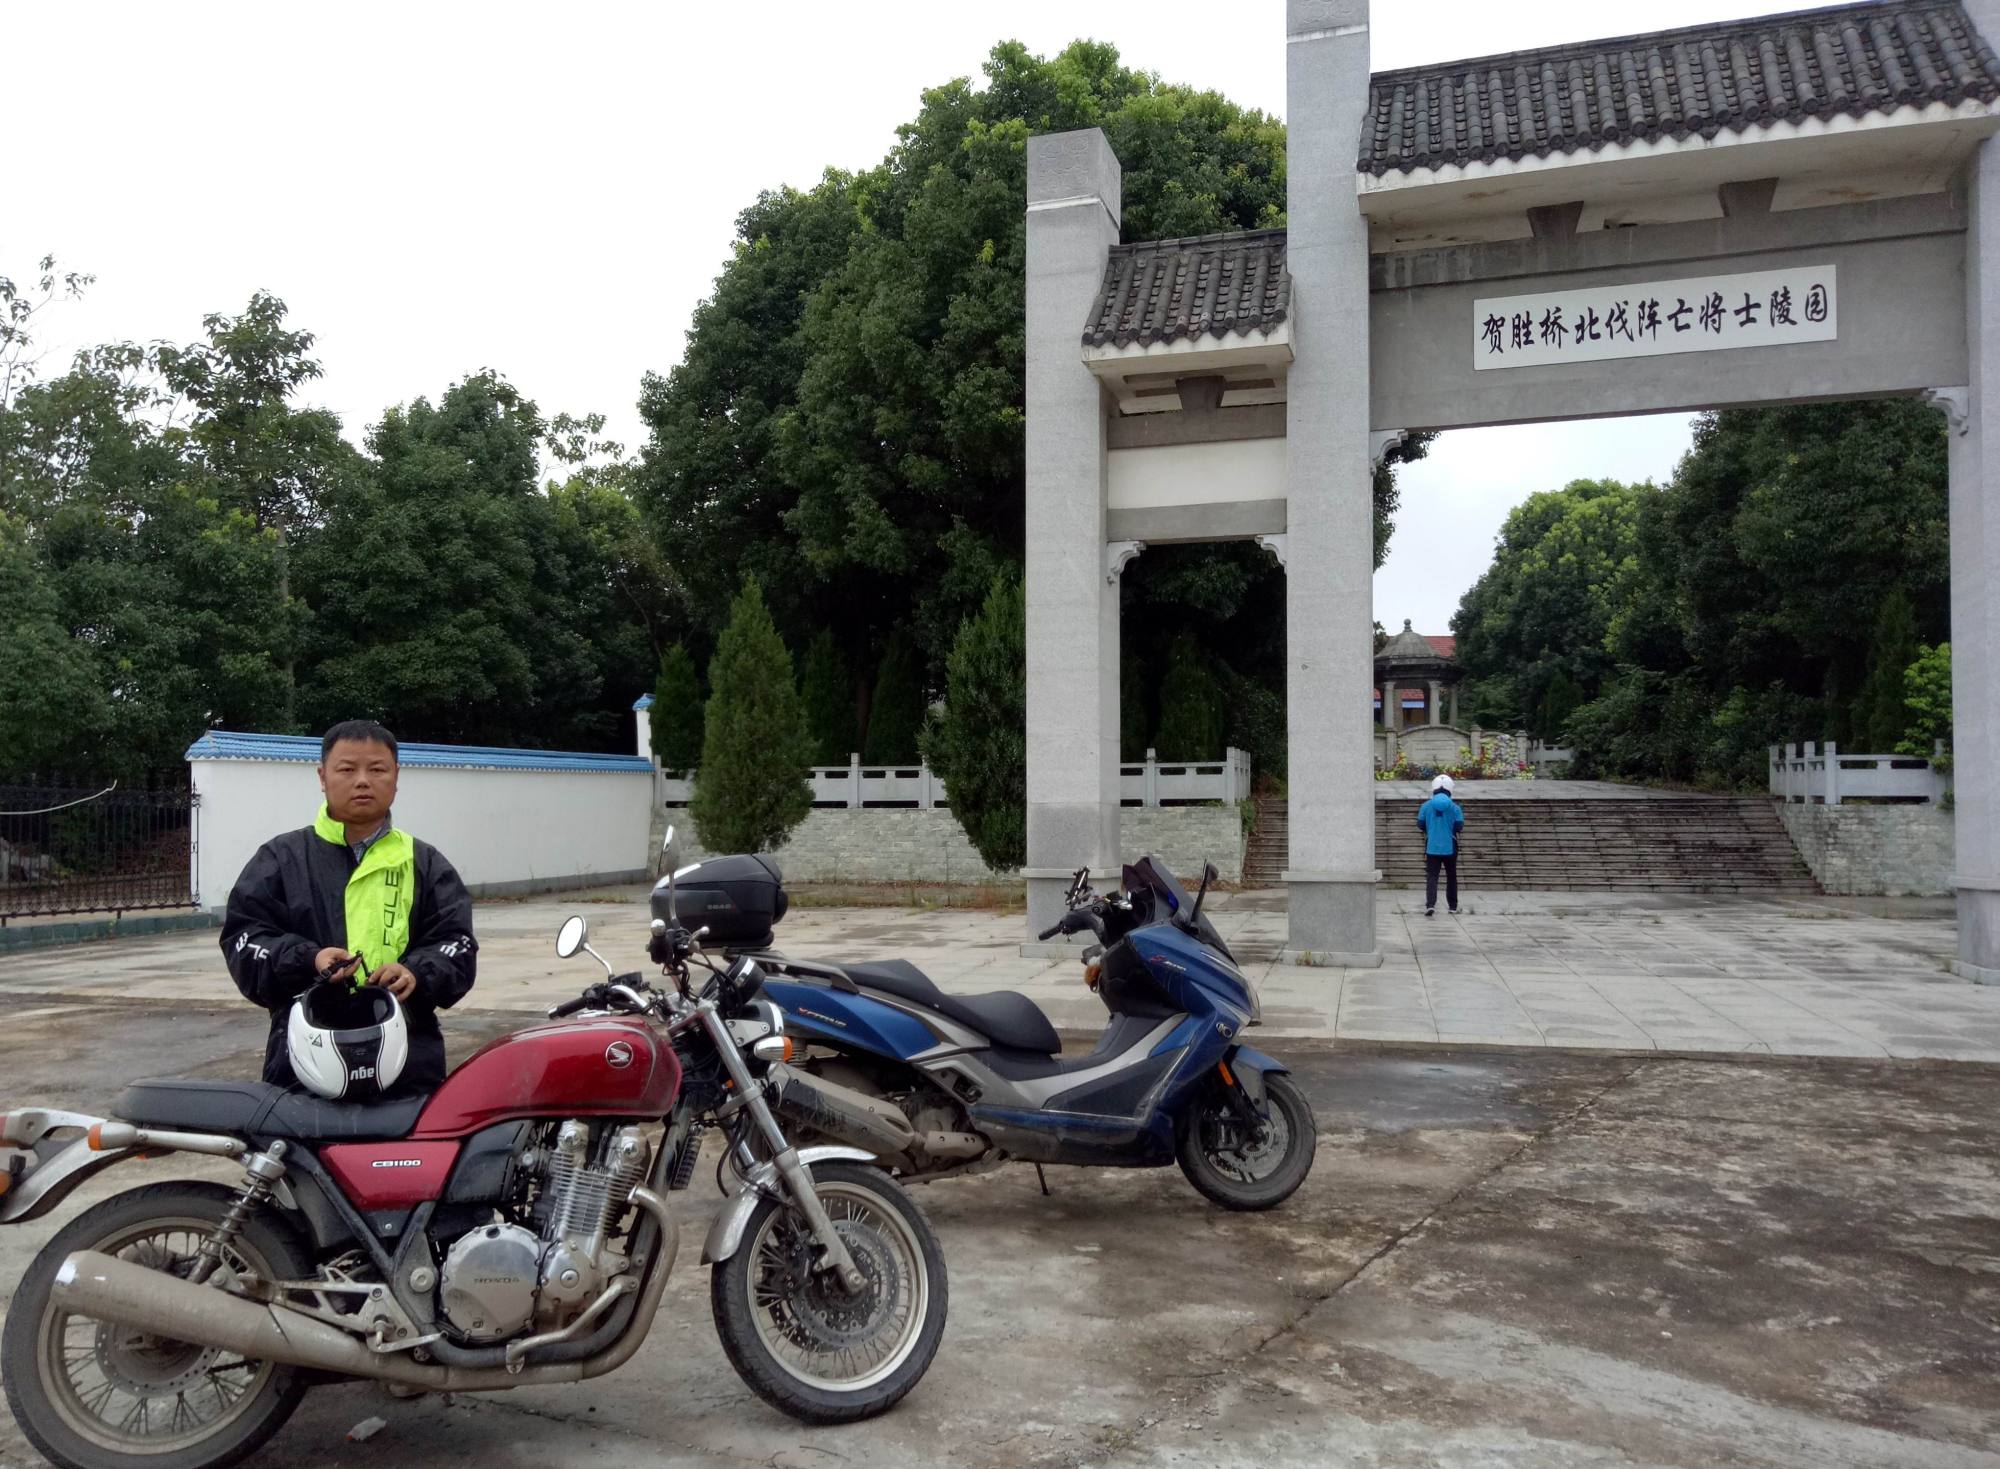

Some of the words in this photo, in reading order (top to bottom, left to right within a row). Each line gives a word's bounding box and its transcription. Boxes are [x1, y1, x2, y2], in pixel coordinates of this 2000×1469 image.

[1481, 283, 1829, 354] 贺胜桥北伐阵亡将士陵园
